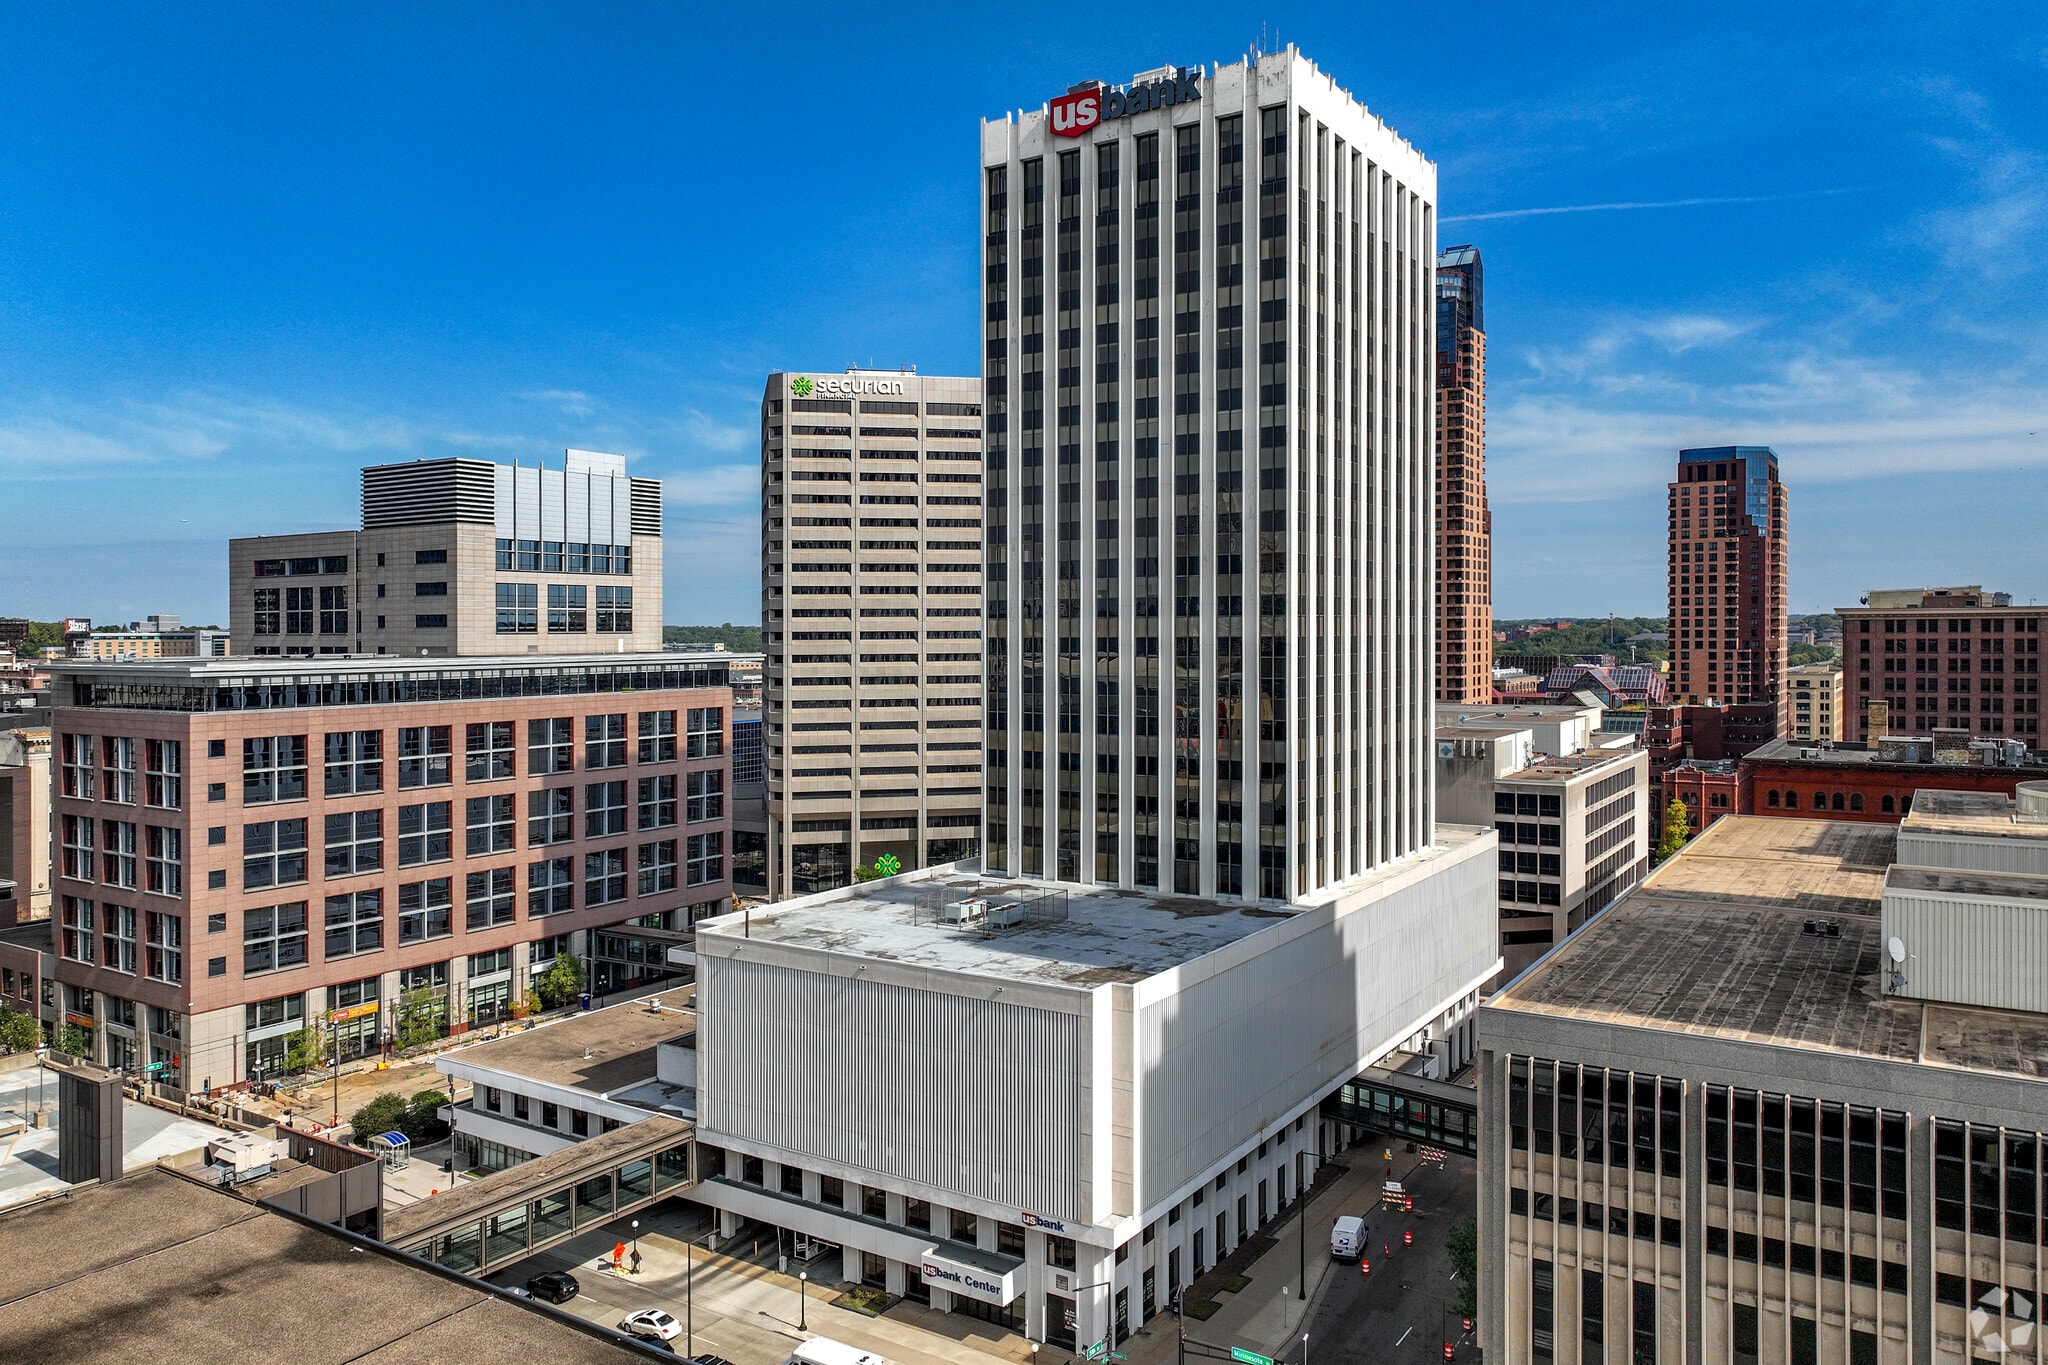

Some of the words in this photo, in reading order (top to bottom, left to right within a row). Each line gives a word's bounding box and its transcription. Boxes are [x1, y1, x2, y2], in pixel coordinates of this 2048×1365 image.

[816, 379, 904, 395] securian
[965, 1275, 1001, 1295] Center
[1233, 1350, 1264, 1365] Minnesota
